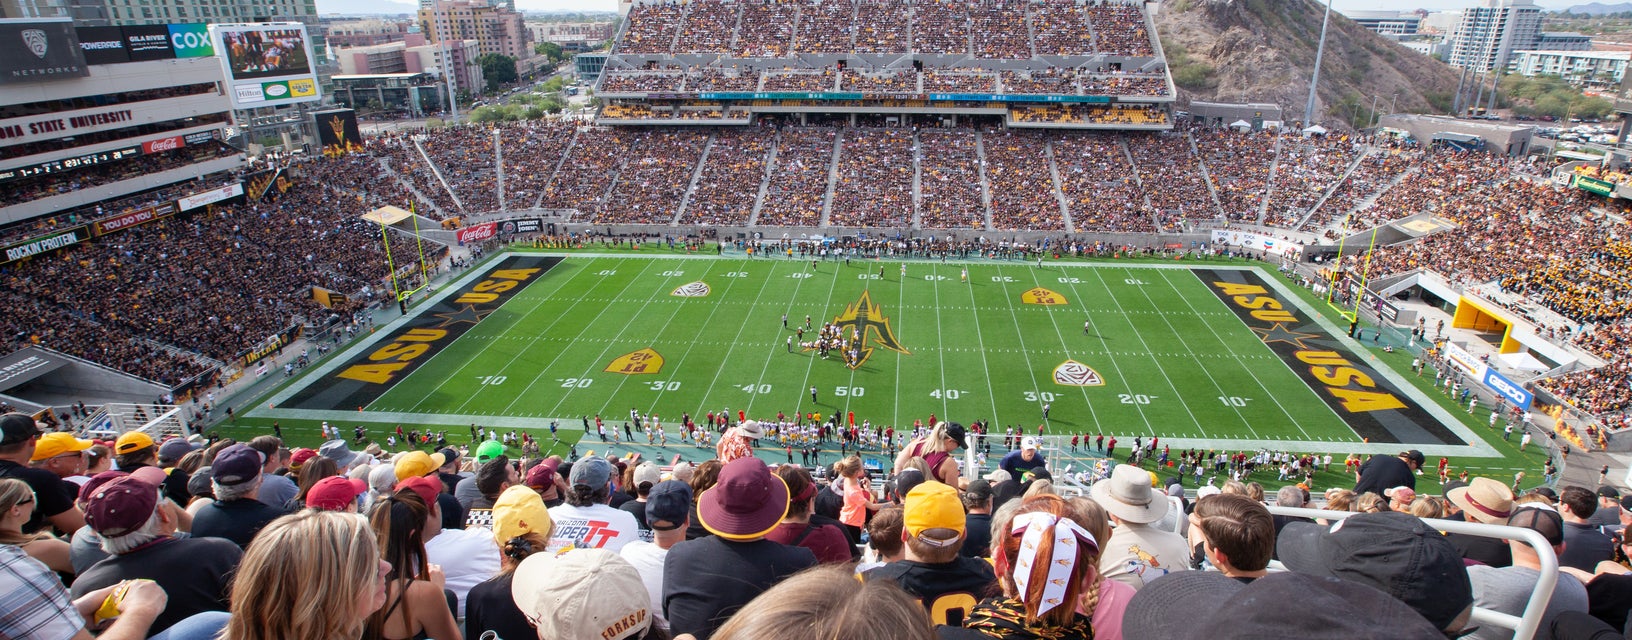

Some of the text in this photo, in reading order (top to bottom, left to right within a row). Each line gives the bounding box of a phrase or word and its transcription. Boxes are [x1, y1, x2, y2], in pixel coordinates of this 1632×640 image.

[171, 32, 211, 49] COX
[12, 66, 79, 76] NETWORKS
[238, 90, 261, 98] Hilton
[29, 119, 66, 134] STATE
[70, 110, 133, 128] UNIVERSITY
[151, 138, 177, 152] Coca-Cola
[103, 211, 151, 231] YOU DO YOU
[517, 220, 539, 228] JIMMY
[461, 225, 492, 242] Coca-Cola
[41, 232, 77, 251] PROTEIN
[454, 267, 541, 303] USA
[1213, 281, 1299, 323] ASU
[335, 328, 448, 385] ASU
[629, 352, 654, 361] 42
[620, 363, 648, 373] PT
[480, 376, 507, 386] 10
[561, 378, 593, 389] 20
[651, 381, 681, 392] 30
[1295, 350, 1409, 413] USA
[742, 384, 772, 395] 40
[834, 386, 865, 397] 50
[929, 389, 960, 400] 40
[1488, 374, 1526, 404] GEICO
[1023, 391, 1056, 402] 30
[1117, 393, 1150, 405] 20
[1218, 396, 1246, 407] 10
[552, 526, 589, 538] UPER
[583, 520, 620, 548] TT
[601, 609, 646, 640] FORKS UP
